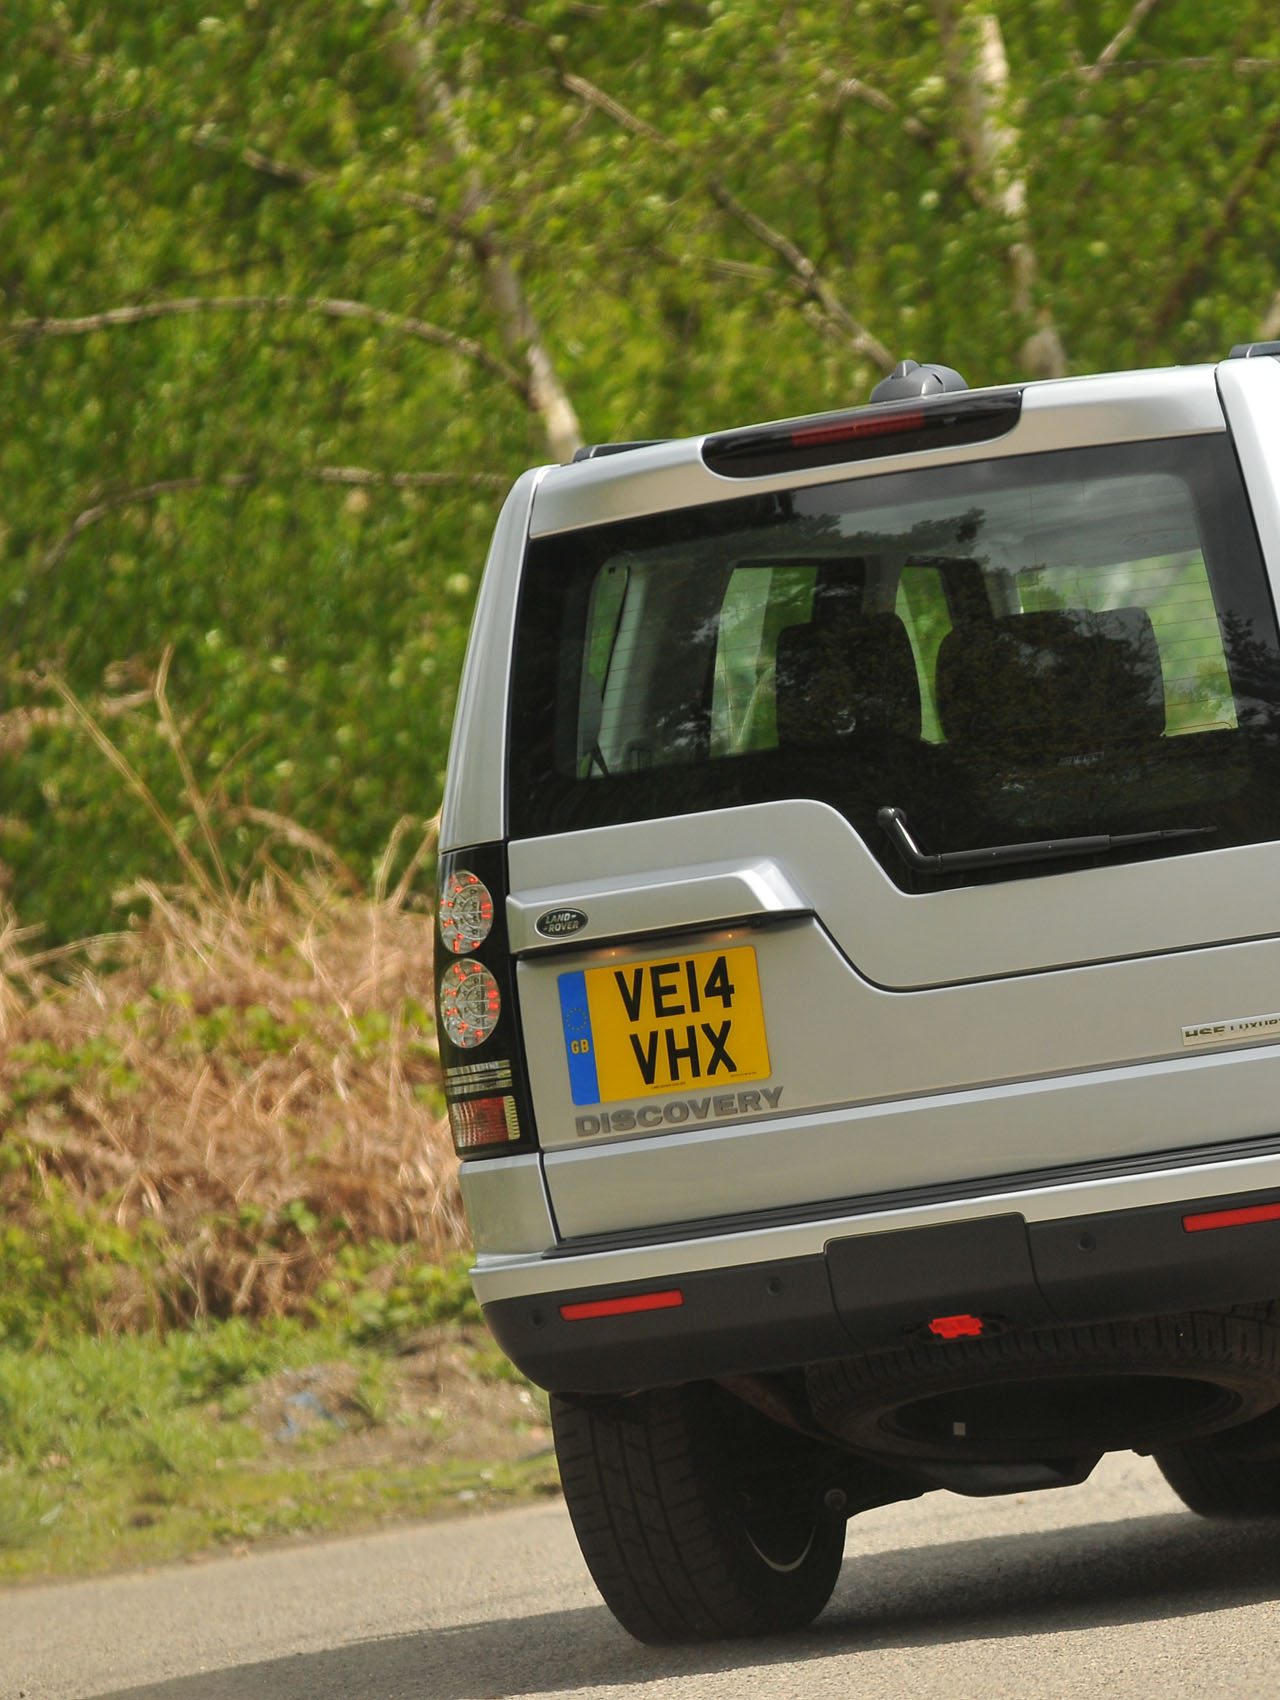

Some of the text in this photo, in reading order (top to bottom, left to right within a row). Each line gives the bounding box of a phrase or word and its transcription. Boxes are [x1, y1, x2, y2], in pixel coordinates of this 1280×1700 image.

[614, 955, 736, 1022] VE14
[571, 1038, 590, 1055] GB
[629, 1020, 738, 1086] VHX
[574, 1086, 784, 1137] DISCOVERY
